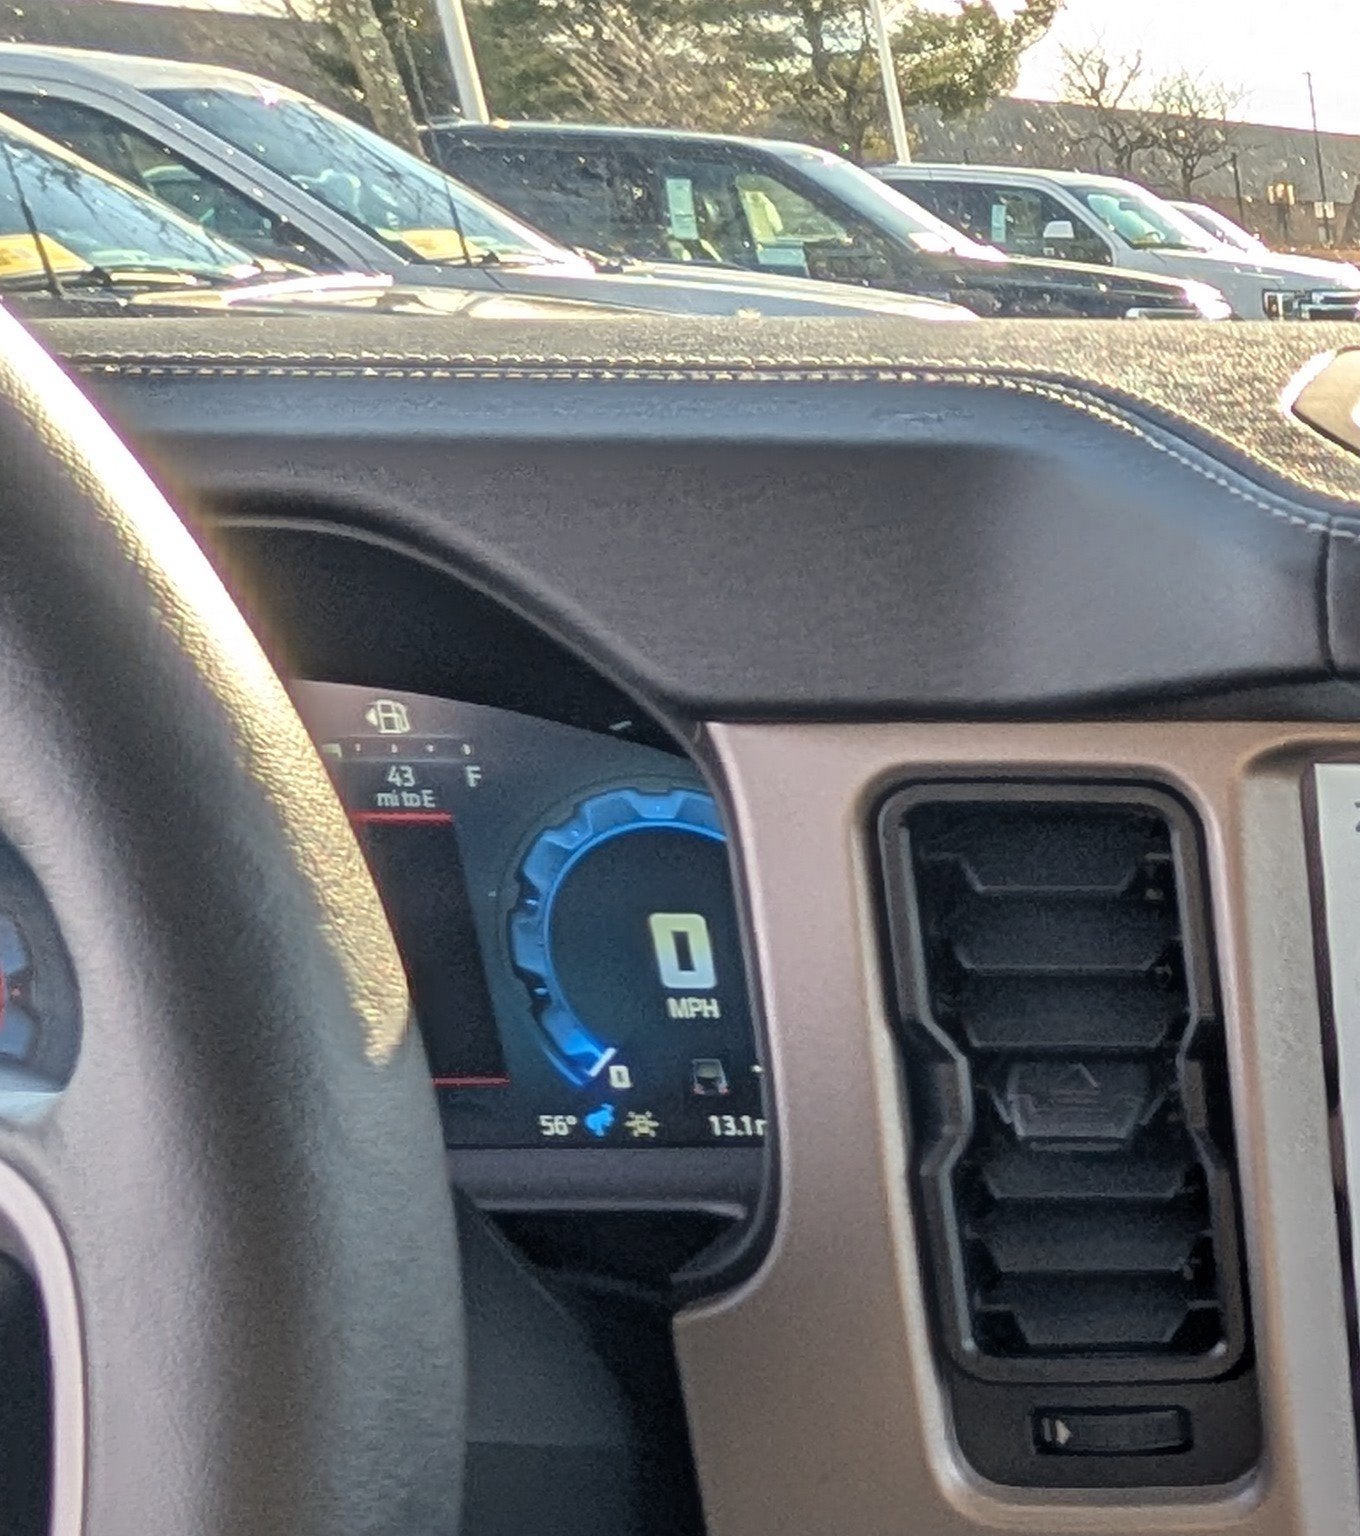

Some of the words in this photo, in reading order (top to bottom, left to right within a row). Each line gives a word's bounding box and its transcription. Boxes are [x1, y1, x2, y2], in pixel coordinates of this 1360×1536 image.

[387, 765, 415, 787] 43
[465, 765, 482, 787] F
[649, 912, 717, 989] 0
[666, 997, 721, 1019] MPH
